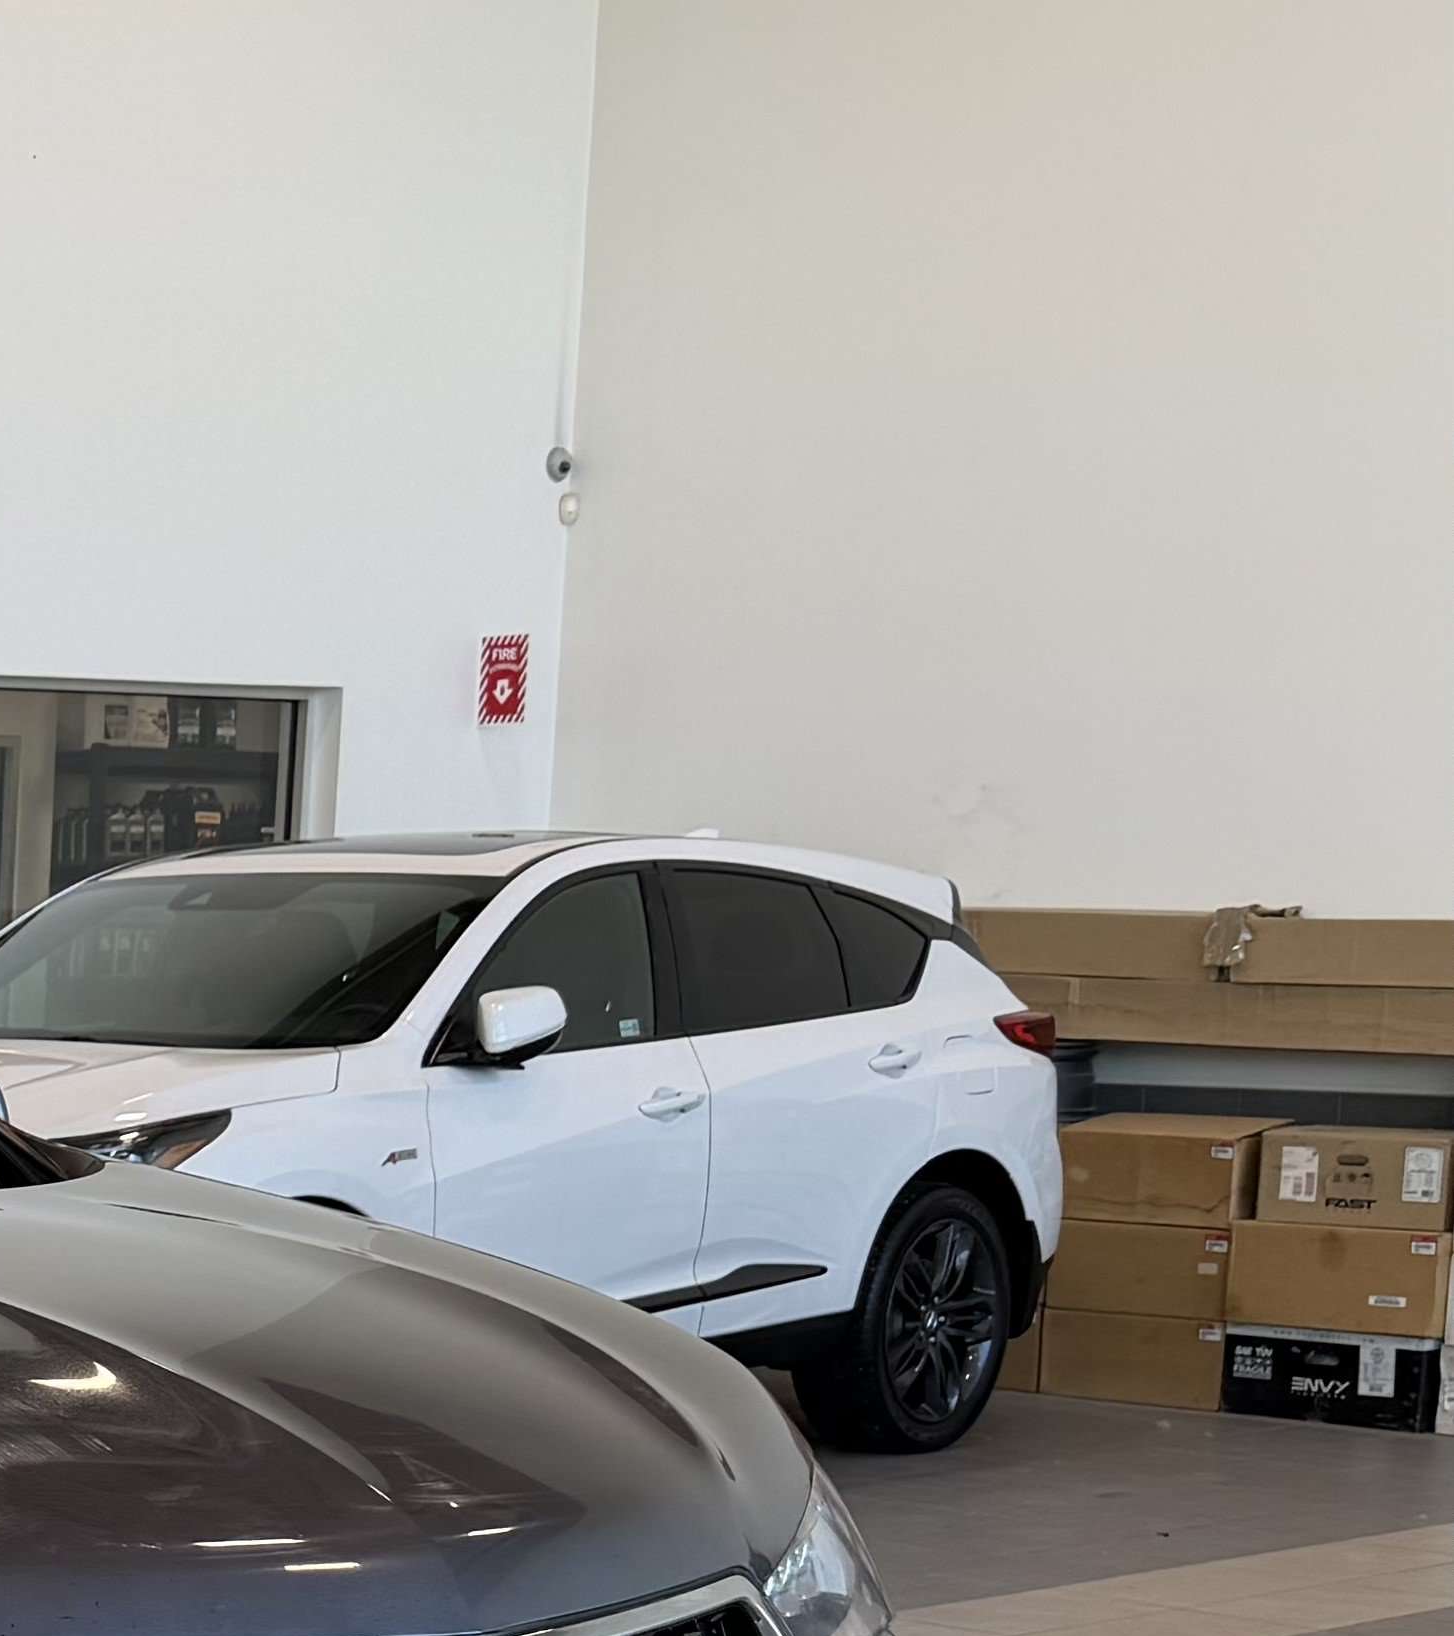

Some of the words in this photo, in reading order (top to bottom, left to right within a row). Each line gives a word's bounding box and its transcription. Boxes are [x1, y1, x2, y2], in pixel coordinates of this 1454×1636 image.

[492, 648, 517, 661] FIRE
[1325, 1198, 1377, 1210] FAST
[1291, 1376, 1350, 1395] ENVY
